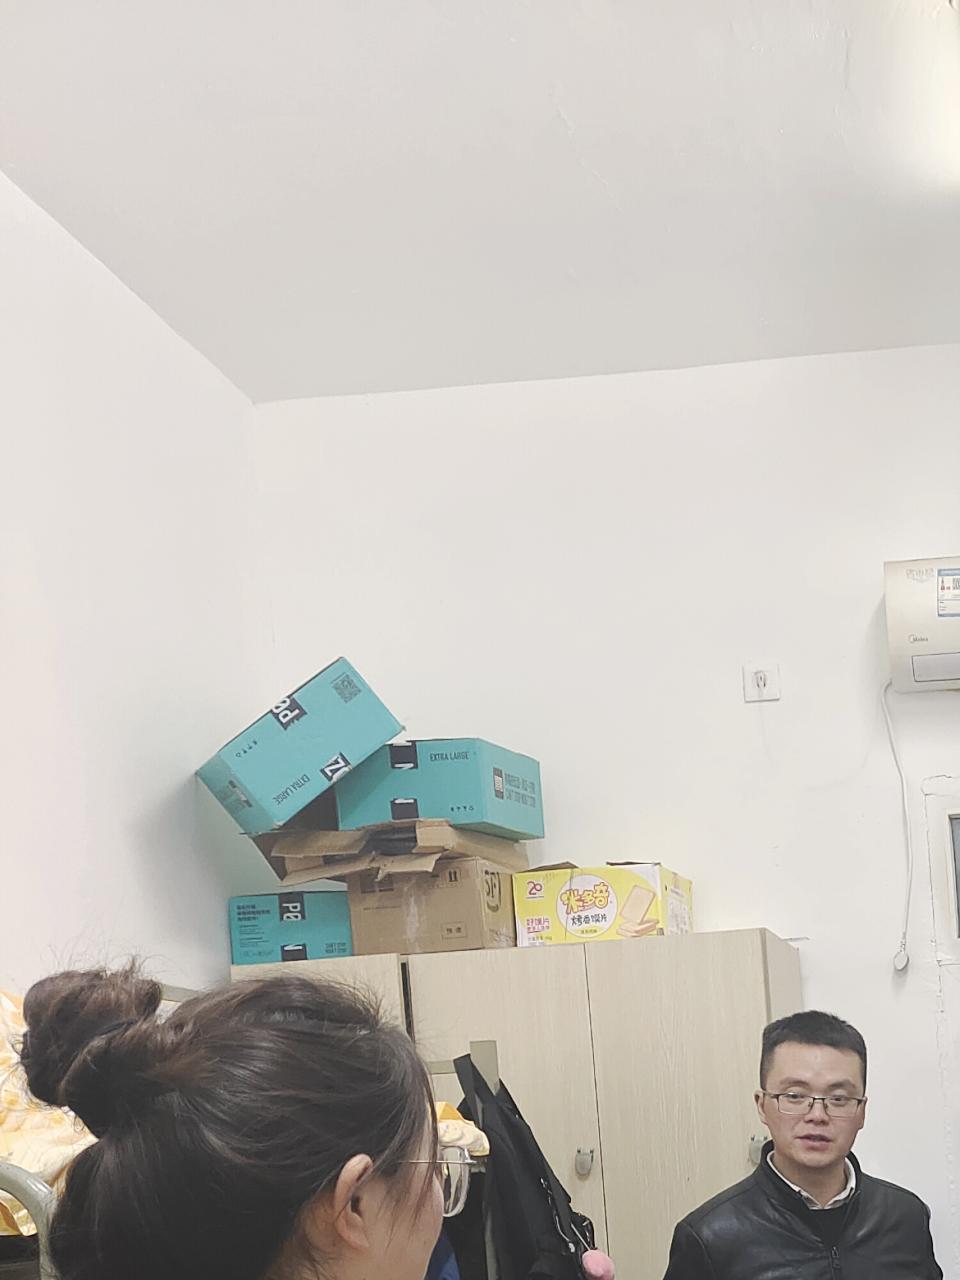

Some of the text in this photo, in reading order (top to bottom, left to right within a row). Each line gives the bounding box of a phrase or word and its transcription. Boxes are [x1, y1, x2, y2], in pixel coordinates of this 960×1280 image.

[430, 751, 471, 761] EXTRA LARGE
[560, 882, 610, 914] 米多奇
[571, 913, 608, 926] 烤香馍片
